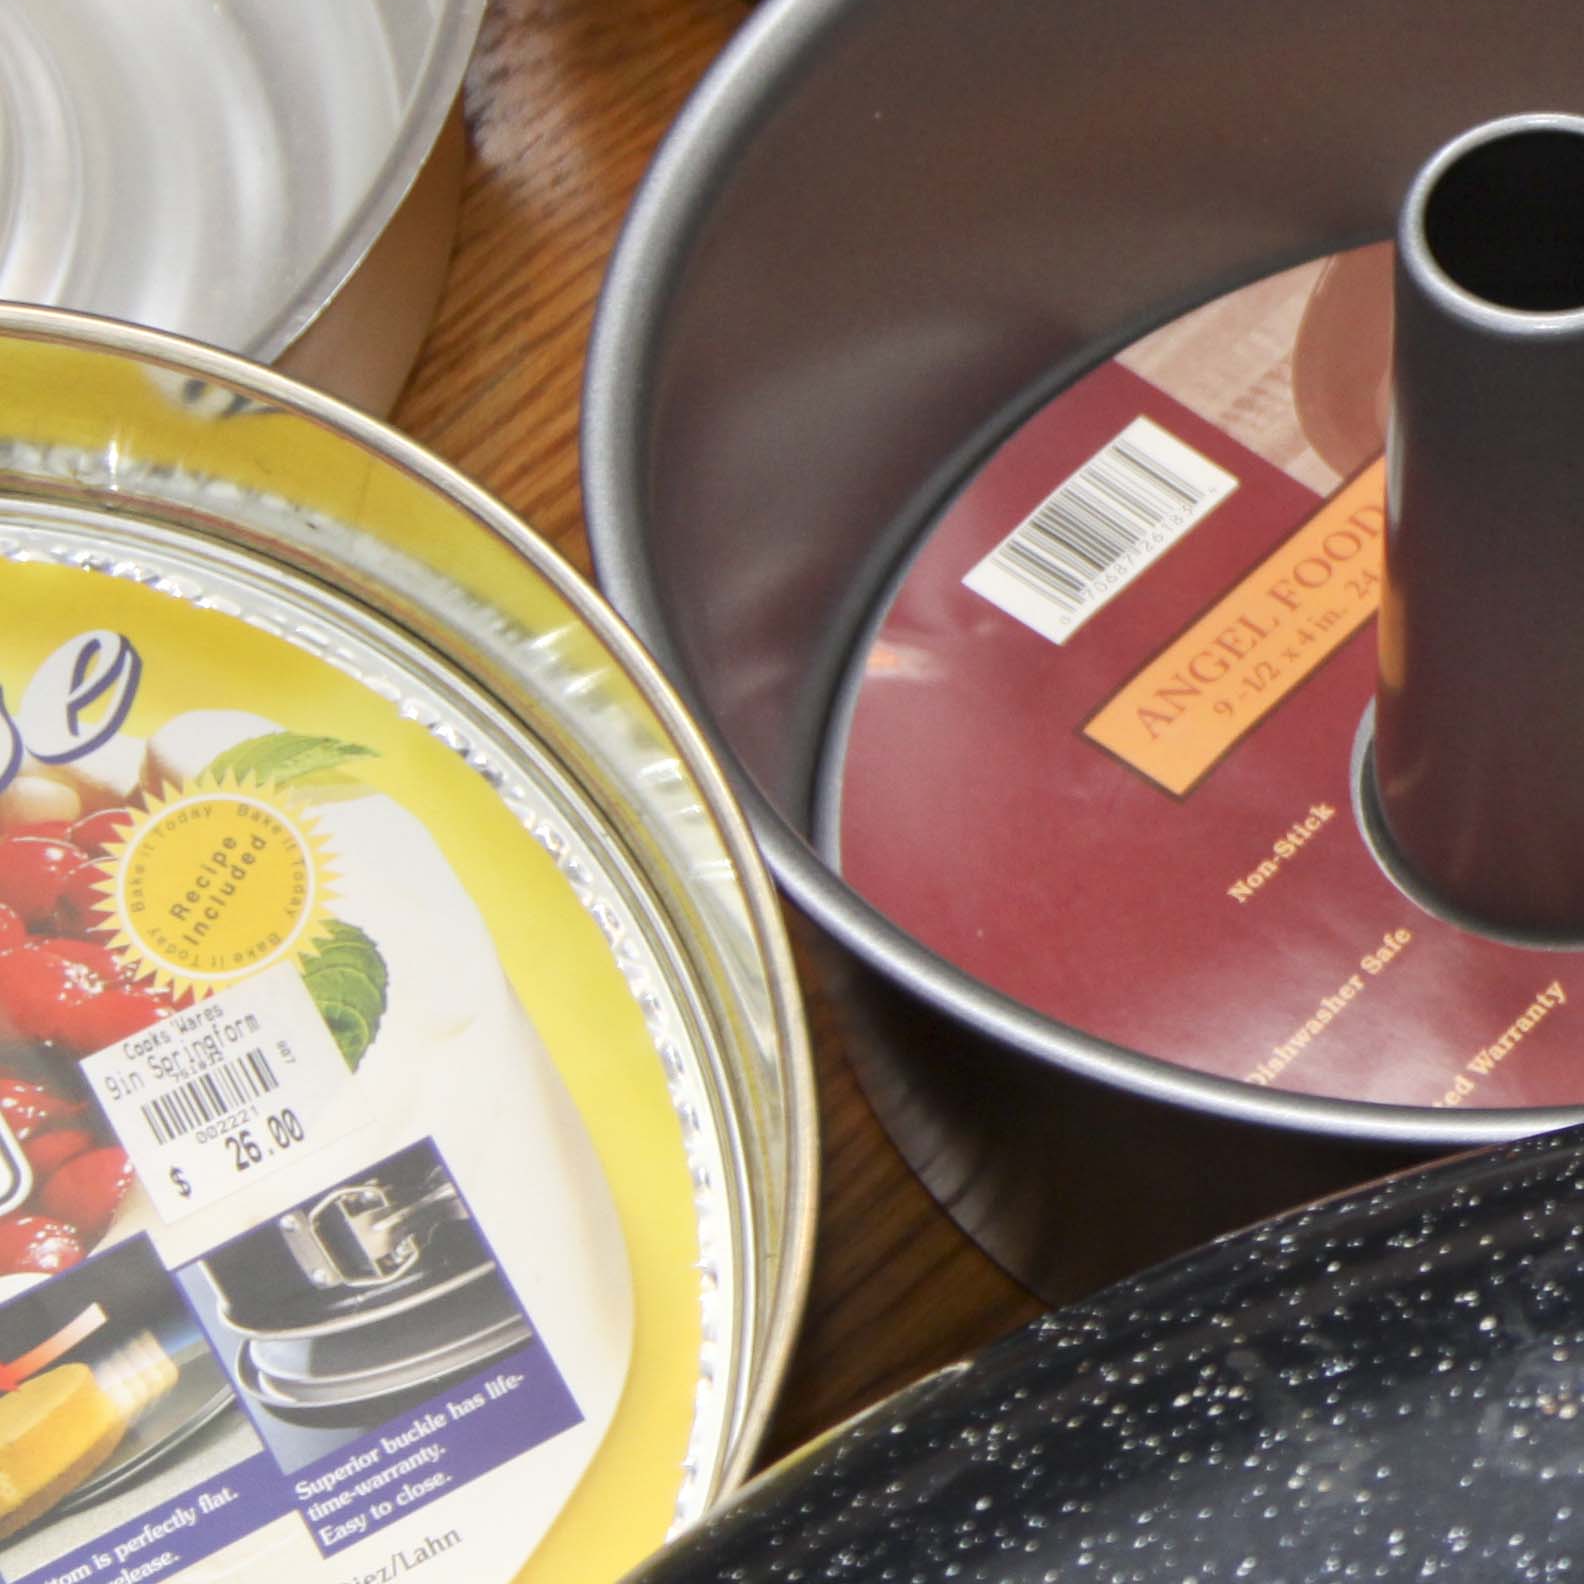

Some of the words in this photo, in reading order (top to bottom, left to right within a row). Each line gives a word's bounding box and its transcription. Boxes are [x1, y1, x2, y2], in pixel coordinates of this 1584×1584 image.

[1135, 612, 1281, 741] ANGEL
[1267, 504, 1385, 612] FOOD
[1296, 625, 1318, 647] 4
[169, 836, 237, 921] Recipe
[182, 834, 267, 946] Included
[1225, 801, 1336, 904] Non-Stick
[1360, 927, 1412, 976] Safe
[104, 1069, 145, 1101] 9in
[147, 1013, 260, 1080] Springform
[122, 1031, 171, 1061] Cooks
[1432, 1074, 1476, 1108] ed
[1466, 980, 1567, 1075] Warranty
[169, 1166, 192, 1199] $
[225, 1108, 304, 1172] 26.00
[195, 1103, 260, 1145] 002221
[295, 1446, 381, 1500] Superior
[379, 1413, 448, 1455] buckle
[446, 1393, 487, 1420] has
[483, 1373, 525, 1400] life-
[307, 1442, 447, 1522] time-warranty.
[318, 1514, 368, 1547] Easy
[369, 1500, 394, 1521] to
[396, 1470, 453, 1507] close.
[91, 1552, 112, 1571] is
[114, 1505, 198, 1564] perfectly
[198, 1486, 240, 1515] flat.
[107, 1550, 180, 1584] elease.
[341, 1528, 463, 1584] ez/Lahn
